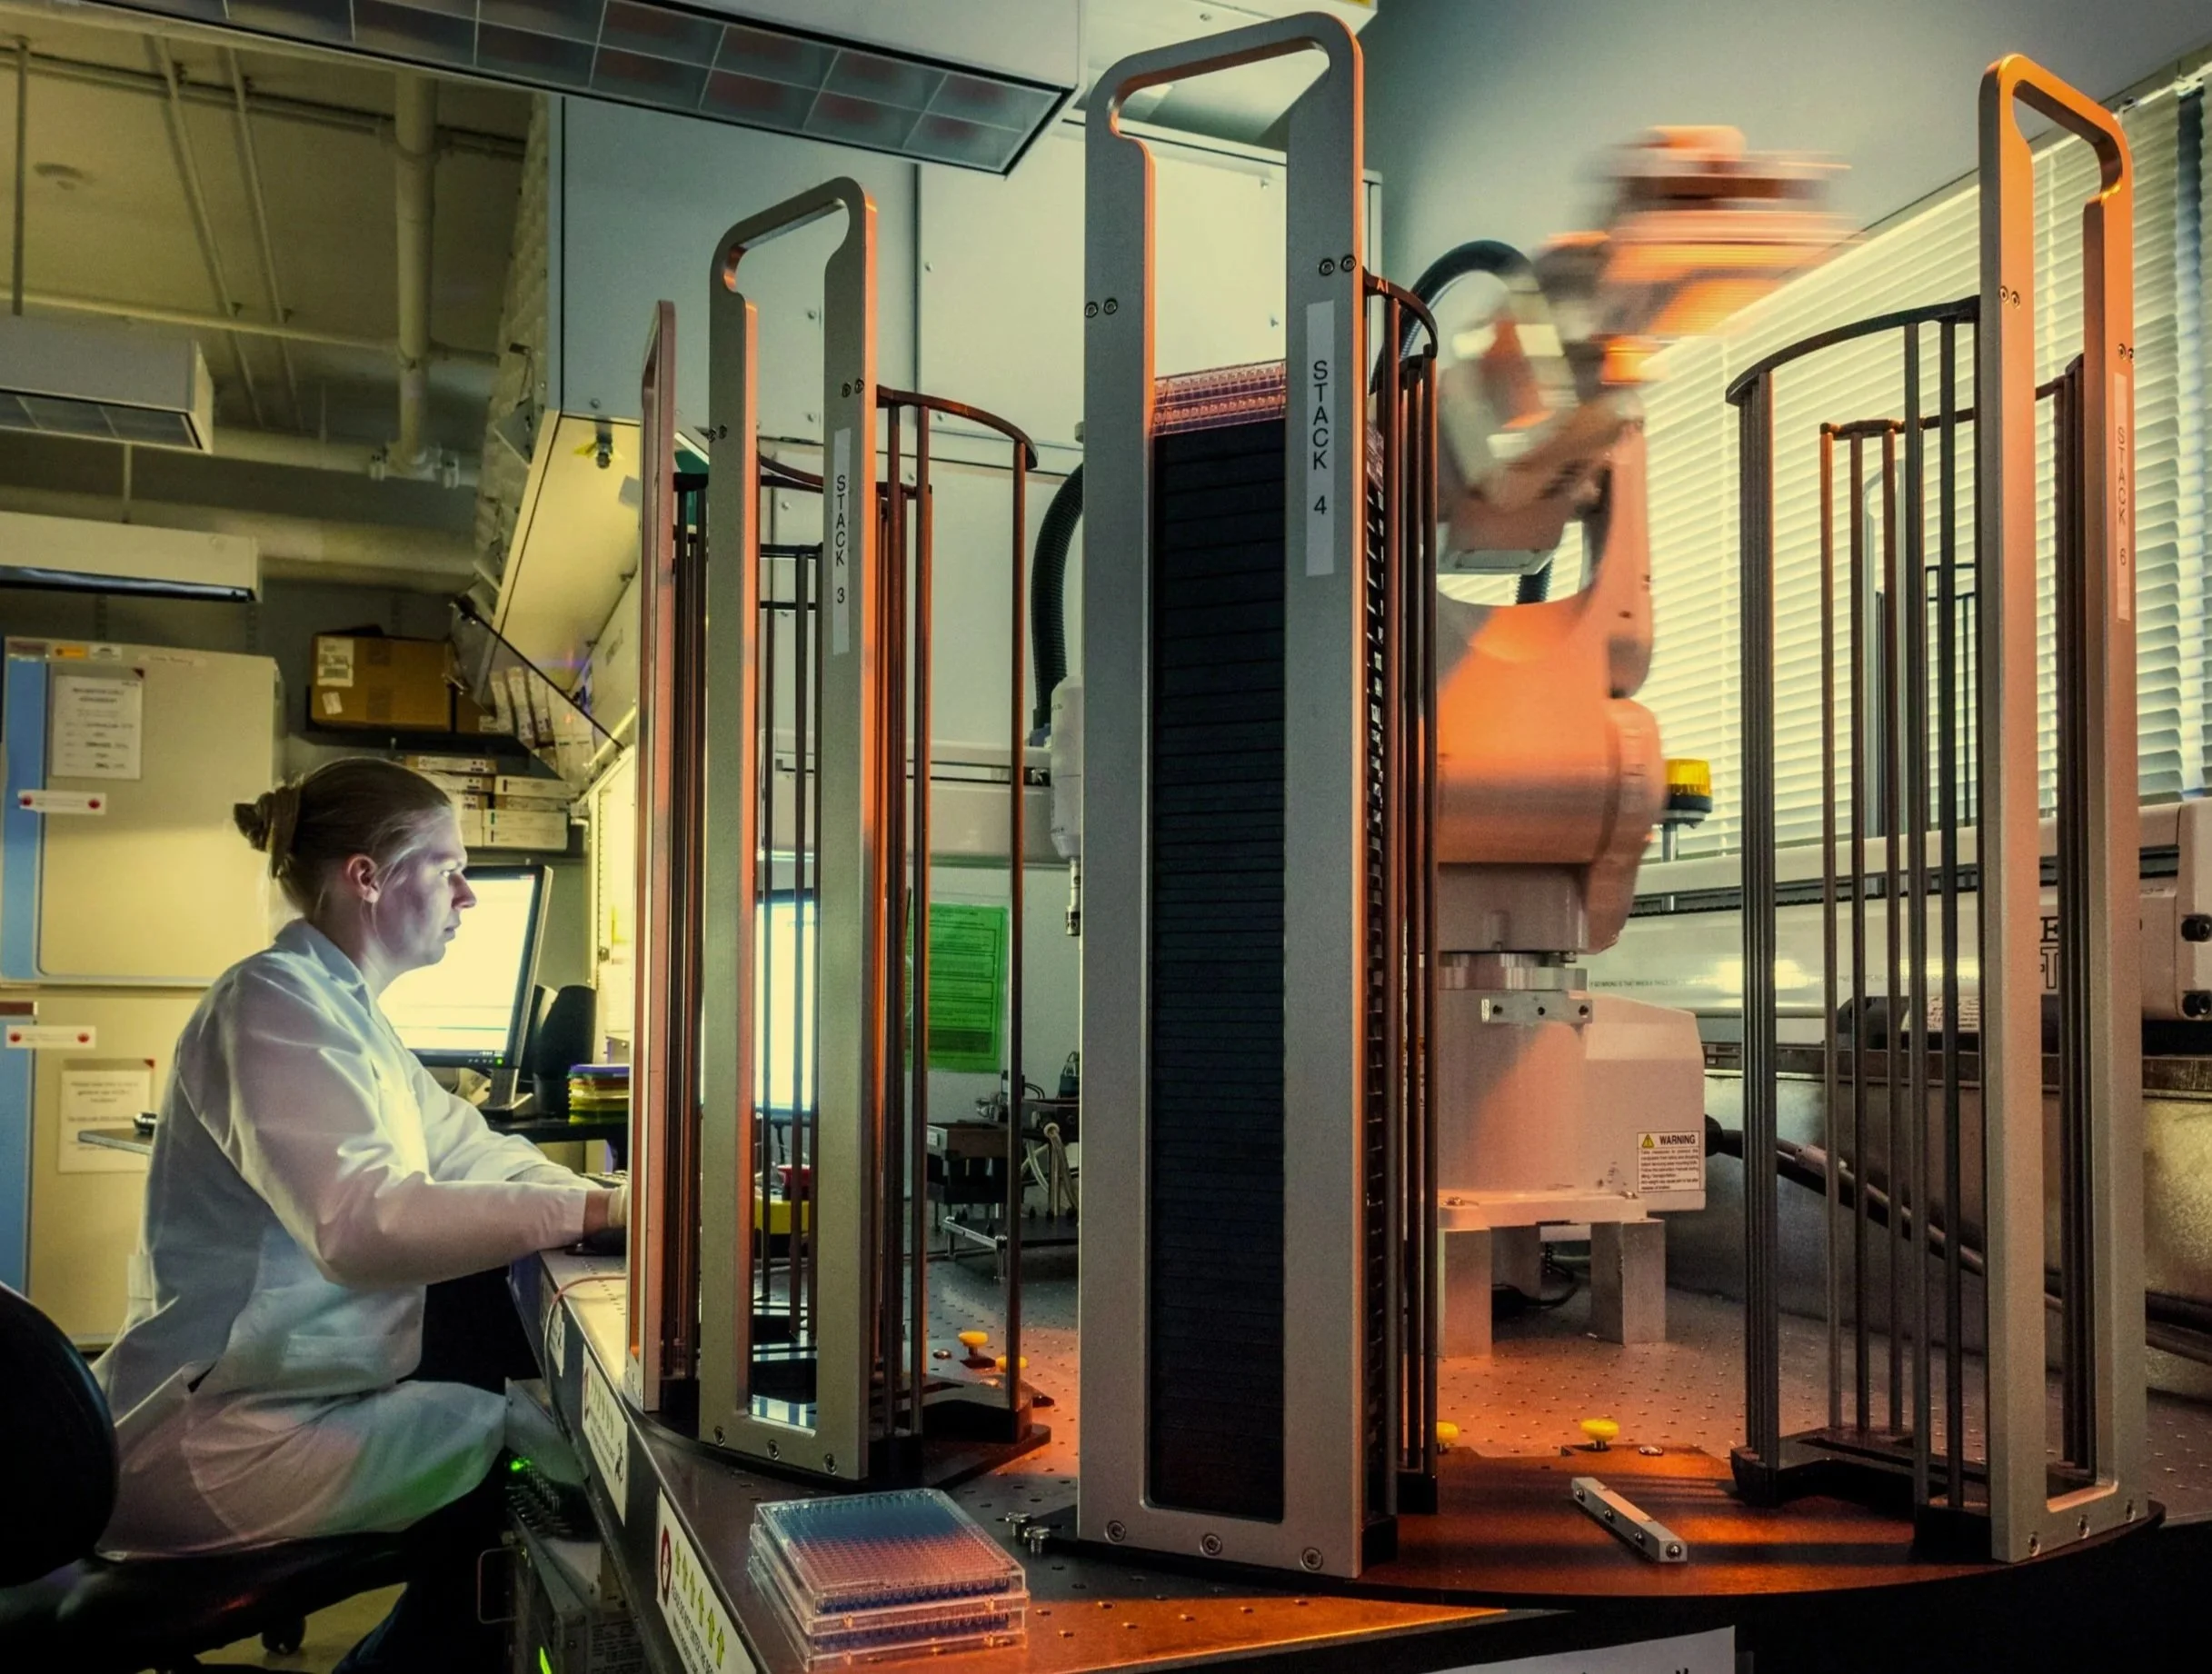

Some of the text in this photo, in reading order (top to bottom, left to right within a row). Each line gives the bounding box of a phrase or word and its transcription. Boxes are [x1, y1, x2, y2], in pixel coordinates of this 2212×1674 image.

[1312, 360, 1329, 515] STACK 4
[2117, 425, 2127, 525] STACK
[836, 474, 846, 604] STACK 3
[1659, 1134, 1696, 1145] WARNING
